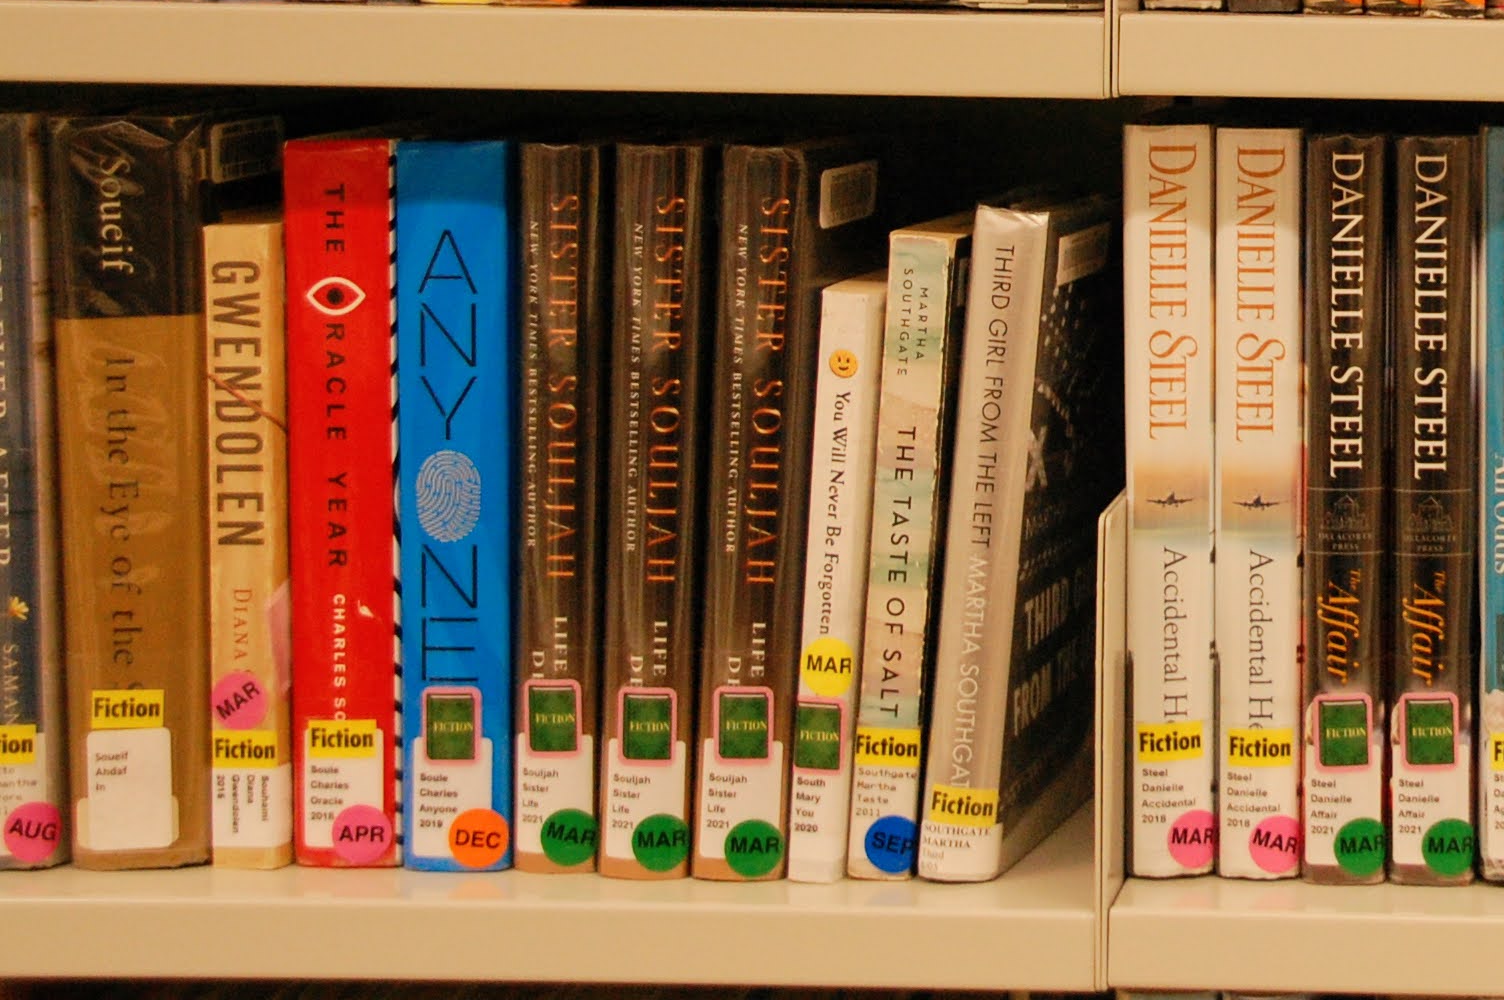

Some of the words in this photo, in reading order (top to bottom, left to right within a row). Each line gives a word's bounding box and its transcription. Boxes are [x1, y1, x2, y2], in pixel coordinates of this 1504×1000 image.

[99, 154, 133, 275] Soueif
[1148, 144, 1197, 320] DANIELLE
[991, 245, 1015, 309] THIRD
[897, 268, 913, 376] SOUTHGATE
[915, 287, 928, 360] MARTHA
[986, 319, 1008, 367] GIRL
[211, 260, 265, 548] GWENDOLEN
[833, 391, 851, 421] You
[980, 376, 1003, 443] FROM
[1148, 330, 1198, 440] STEEL
[830, 427, 848, 464] Will
[895, 426, 916, 481] THE
[827, 470, 845, 520] Never
[974, 453, 997, 494] THE
[825, 526, 841, 546] Be
[888, 496, 912, 583] TASTE
[972, 500, 992, 548] LEFT
[818, 552, 840, 635] Forgotten
[886, 597, 904, 635] OF
[1163, 547, 1188, 683] Accidental
[1317, 581, 1360, 685] Affair
[880, 649, 902, 718] SALT
[94, 699, 160, 719] Fiction
[310, 781, 349, 790] Charles
[420, 805, 458, 815] Anyone
[1142, 783, 1184, 792] Danielle
[338, 825, 384, 843] APR
[455, 830, 501, 849] DEC
[638, 831, 687, 847] MAR
